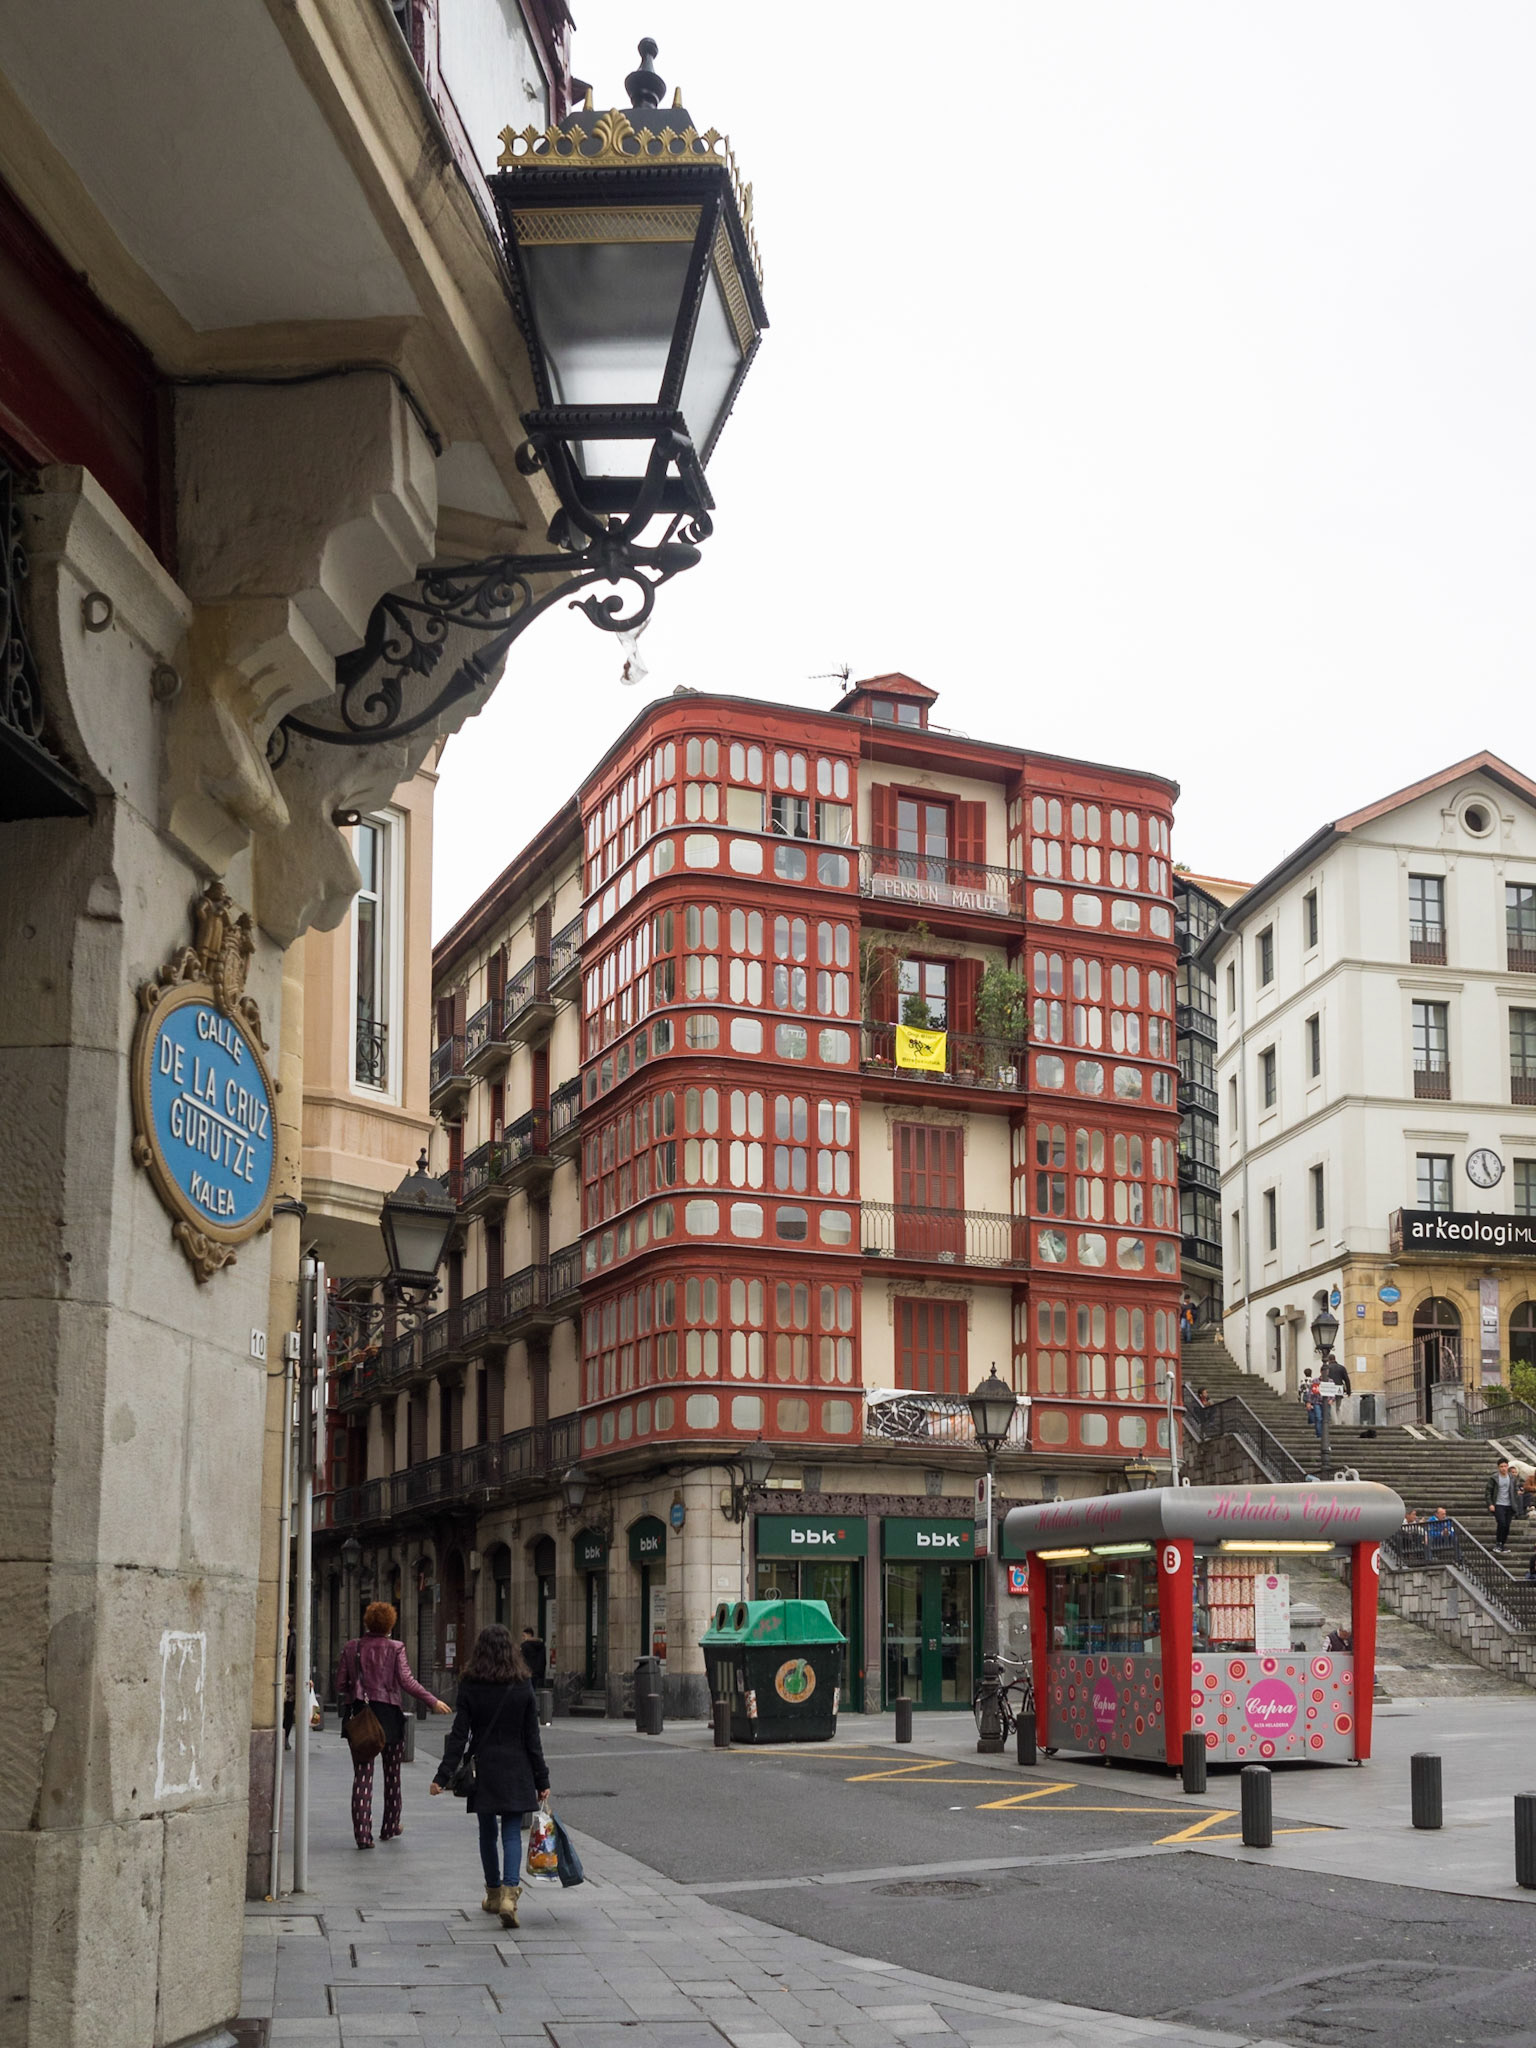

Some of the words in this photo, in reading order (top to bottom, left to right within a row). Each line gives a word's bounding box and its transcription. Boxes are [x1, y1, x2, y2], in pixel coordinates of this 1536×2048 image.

[885, 880, 938, 902] PENSION
[952, 891, 999, 912] MATILDE
[197, 1011, 244, 1065] CALLE
[160, 1035, 185, 1085] DE
[193, 1057, 216, 1105] LA
[225, 1079, 270, 1139] CRUZ
[171, 1098, 255, 1182] GURUTZE
[190, 1171, 235, 1215] KALEA
[252, 1332, 265, 1356] 10
[1034, 1506, 1080, 1531] Helados
[1085, 1501, 1122, 1533] Capra
[1207, 1492, 1291, 1521] Helados
[1299, 1492, 1362, 1533] Capra
[640, 1536, 658, 1551] bbk
[791, 1529, 836, 1544] bbk
[917, 1532, 960, 1547] bbk
[584, 1546, 600, 1559] bbk
[1166, 1551, 1176, 1568] B
[1093, 1694, 1116, 1716] Capra
[1245, 1697, 1296, 1720] Capra
